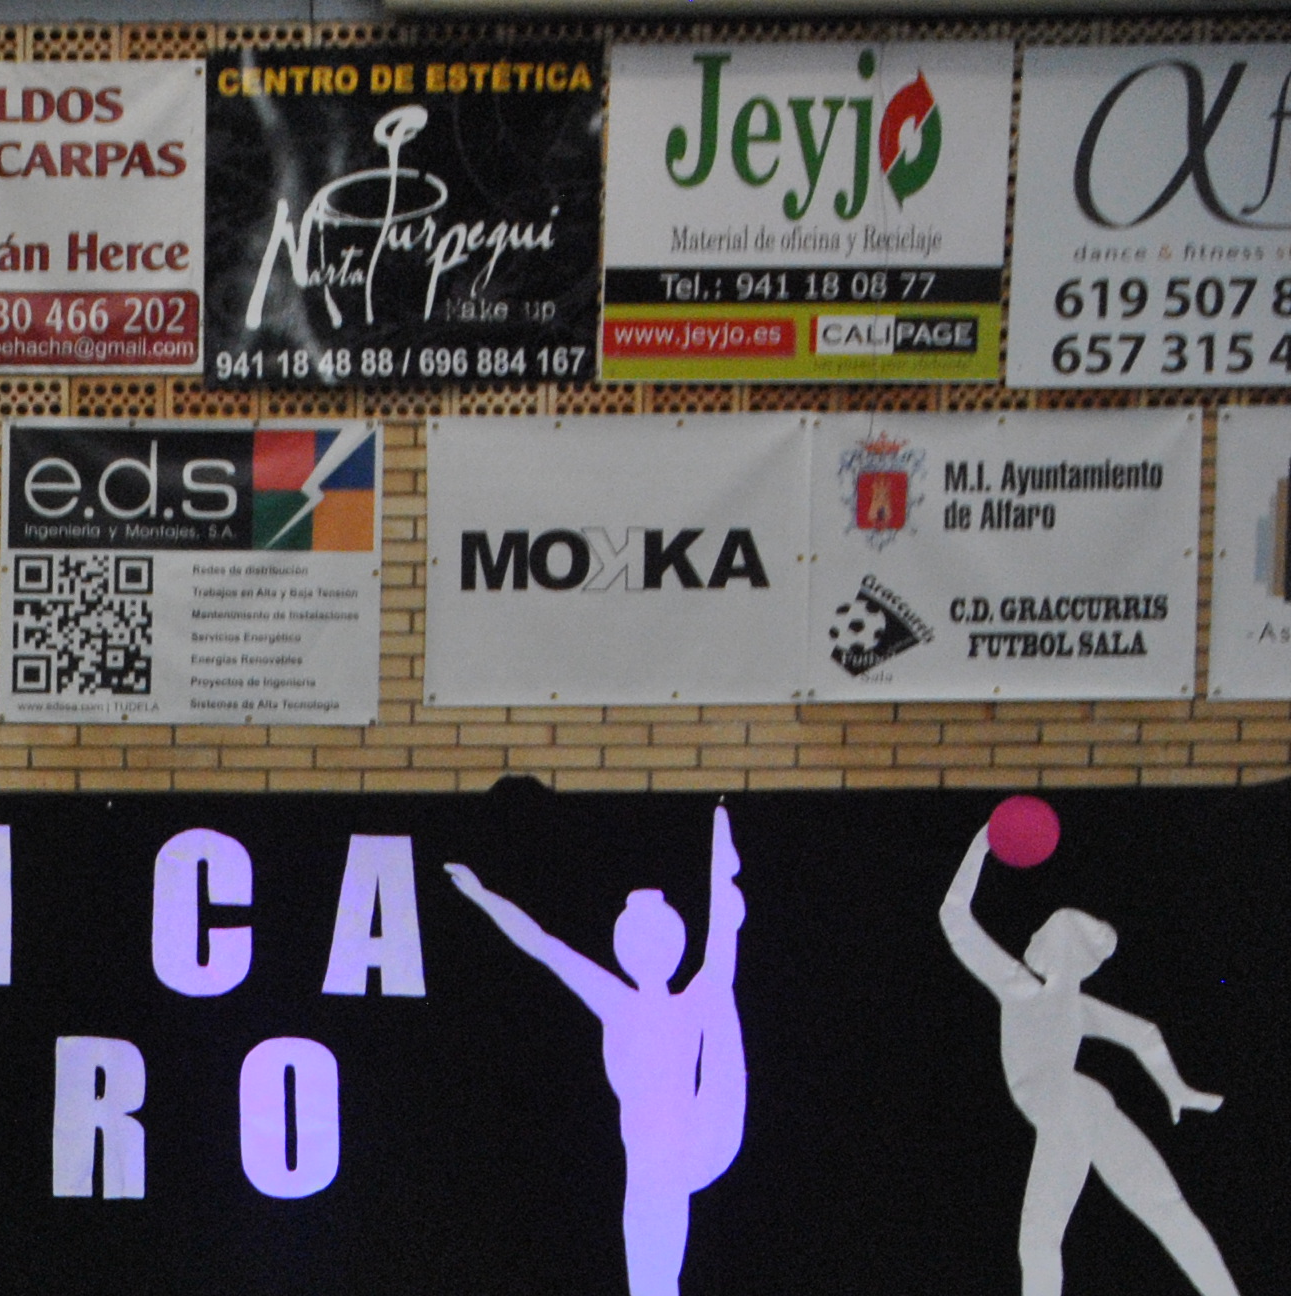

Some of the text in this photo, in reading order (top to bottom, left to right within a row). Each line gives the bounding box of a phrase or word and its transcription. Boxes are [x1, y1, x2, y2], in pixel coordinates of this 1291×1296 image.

[218, 65, 359, 97] CENTRO
[370, 63, 415, 95] DE
[67, 231, 190, 272] Herce
[671, 224, 943, 258] Material de oficina y Reciclaje
[1073, 241, 1147, 263] dance
[736, 272, 790, 300] 941
[806, 272, 839, 300] 18
[851, 272, 888, 300] 08
[901, 271, 937, 299] 77
[1054, 276, 1149, 320] 619
[1163, 276, 1258, 320] 507
[45, 297, 109, 333] 466
[123, 297, 186, 333] 202
[614, 322, 782, 349] www.jeyjo.es
[216, 348, 264, 380] 941
[277, 348, 309, 379] 18
[318, 347, 351, 377] 48
[361, 347, 394, 377] 88
[419, 346, 469, 377] 696
[477, 346, 527, 376] 884
[537, 345, 587, 376] 167
[1051, 331, 1146, 376] 657
[1160, 331, 1254, 375] 315
[24, 439, 238, 520] e.d.s
[943, 457, 1164, 496] M.I. Ayuntamiento
[943, 499, 1057, 531] de Alfaro
[109, 525, 118, 541] y
[949, 593, 1169, 624] C.D. GRACCURRIS
[967, 628, 1149, 659] FUTBOL SALA
